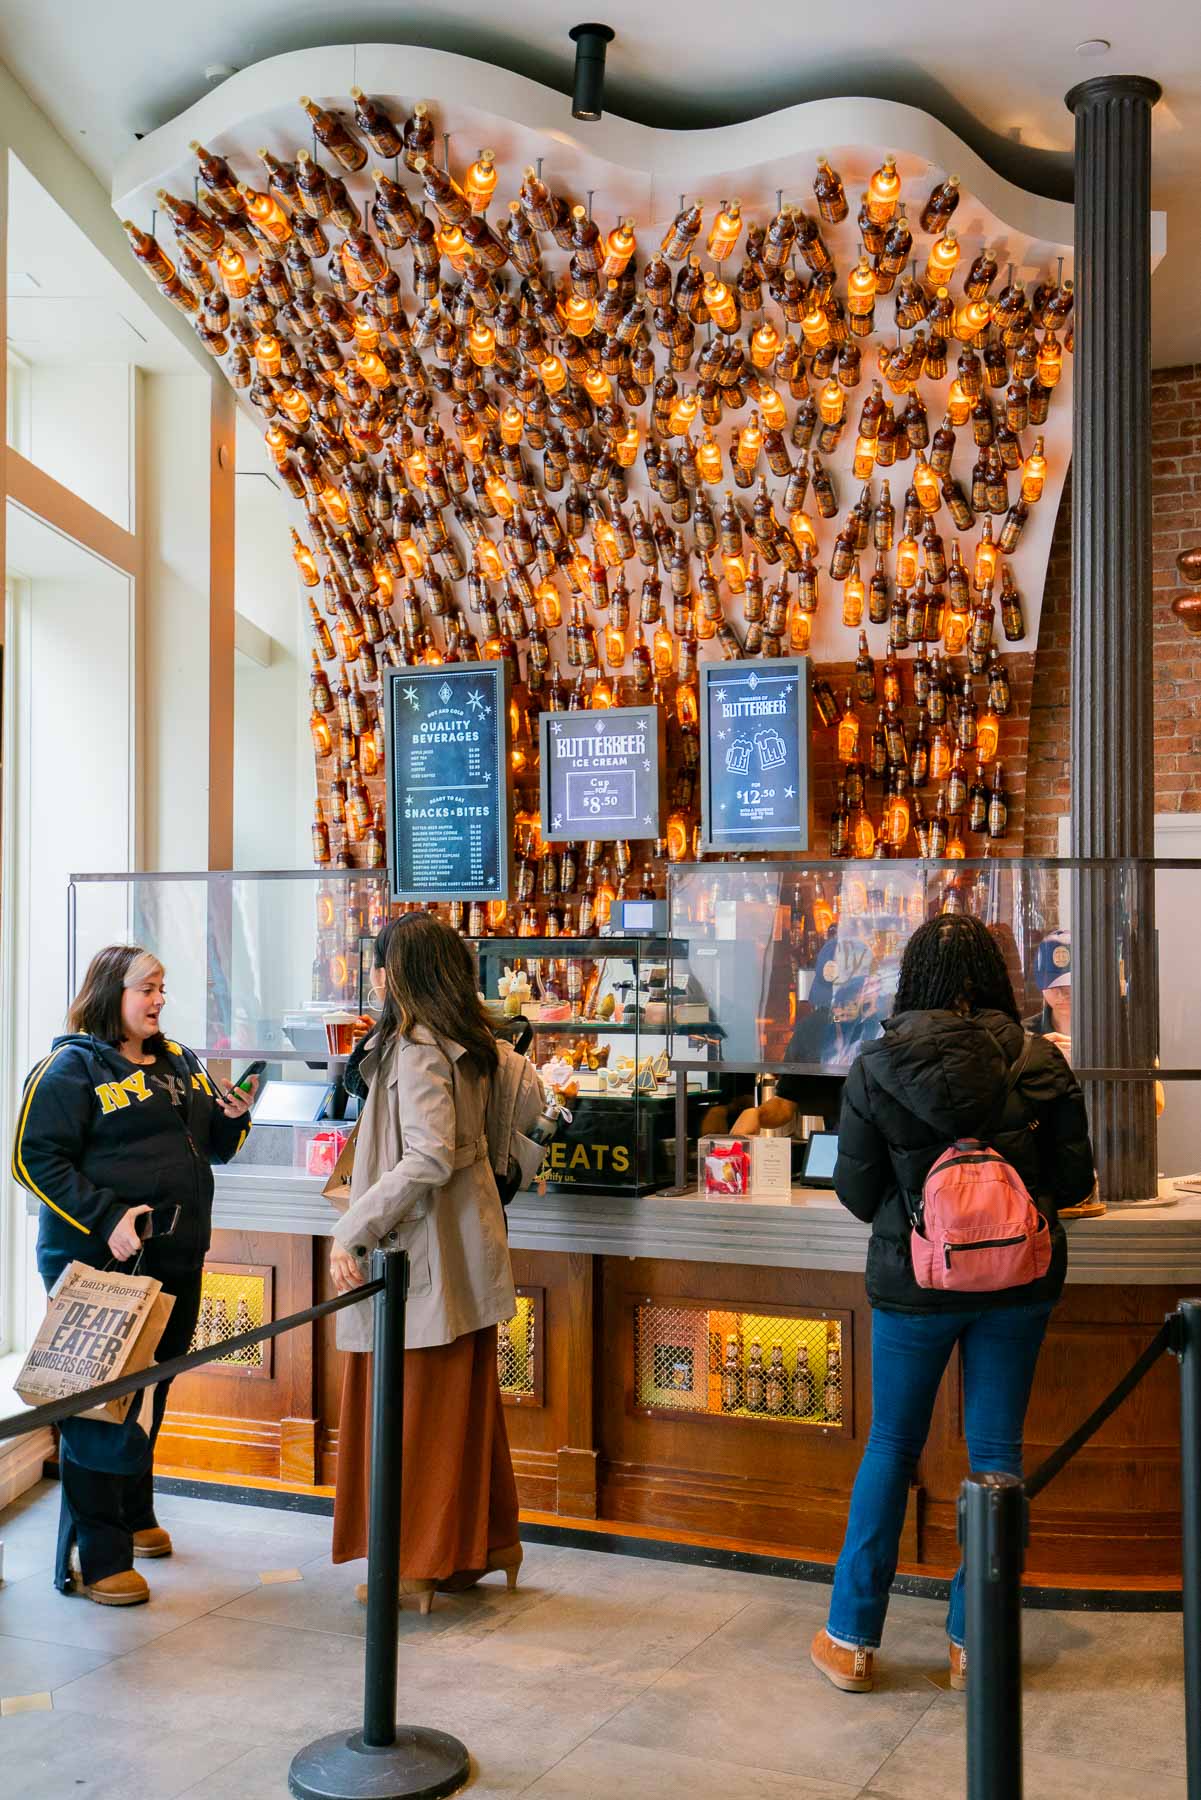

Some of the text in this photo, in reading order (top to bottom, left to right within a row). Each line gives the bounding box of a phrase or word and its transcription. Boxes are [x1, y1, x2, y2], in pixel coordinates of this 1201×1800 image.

[450, 708, 464, 716] COLD
[722, 700, 787, 718] BUTTERBEER
[420, 720, 471, 733] QUALITY
[412, 732, 480, 744] BEVERAGES
[556, 734, 646, 758] BUTTERBEER
[572, 757, 627, 768] ICE CREAM
[590, 778, 610, 788] Cup
[430, 795, 446, 804] READY
[455, 796, 465, 804] EAT
[583, 796, 618, 814] $8.50
[736, 788, 776, 805] $12.50
[404, 807, 449, 819] SNACKS
[456, 806, 490, 817] BITES
[95, 1069, 153, 1114] NY
[80, 1280, 151, 1300] DAILY PROPHET
[62, 1302, 138, 1340] DEATH
[49, 1326, 123, 1366] EATER
[27, 1350, 112, 1381] NUMBERS GROW
